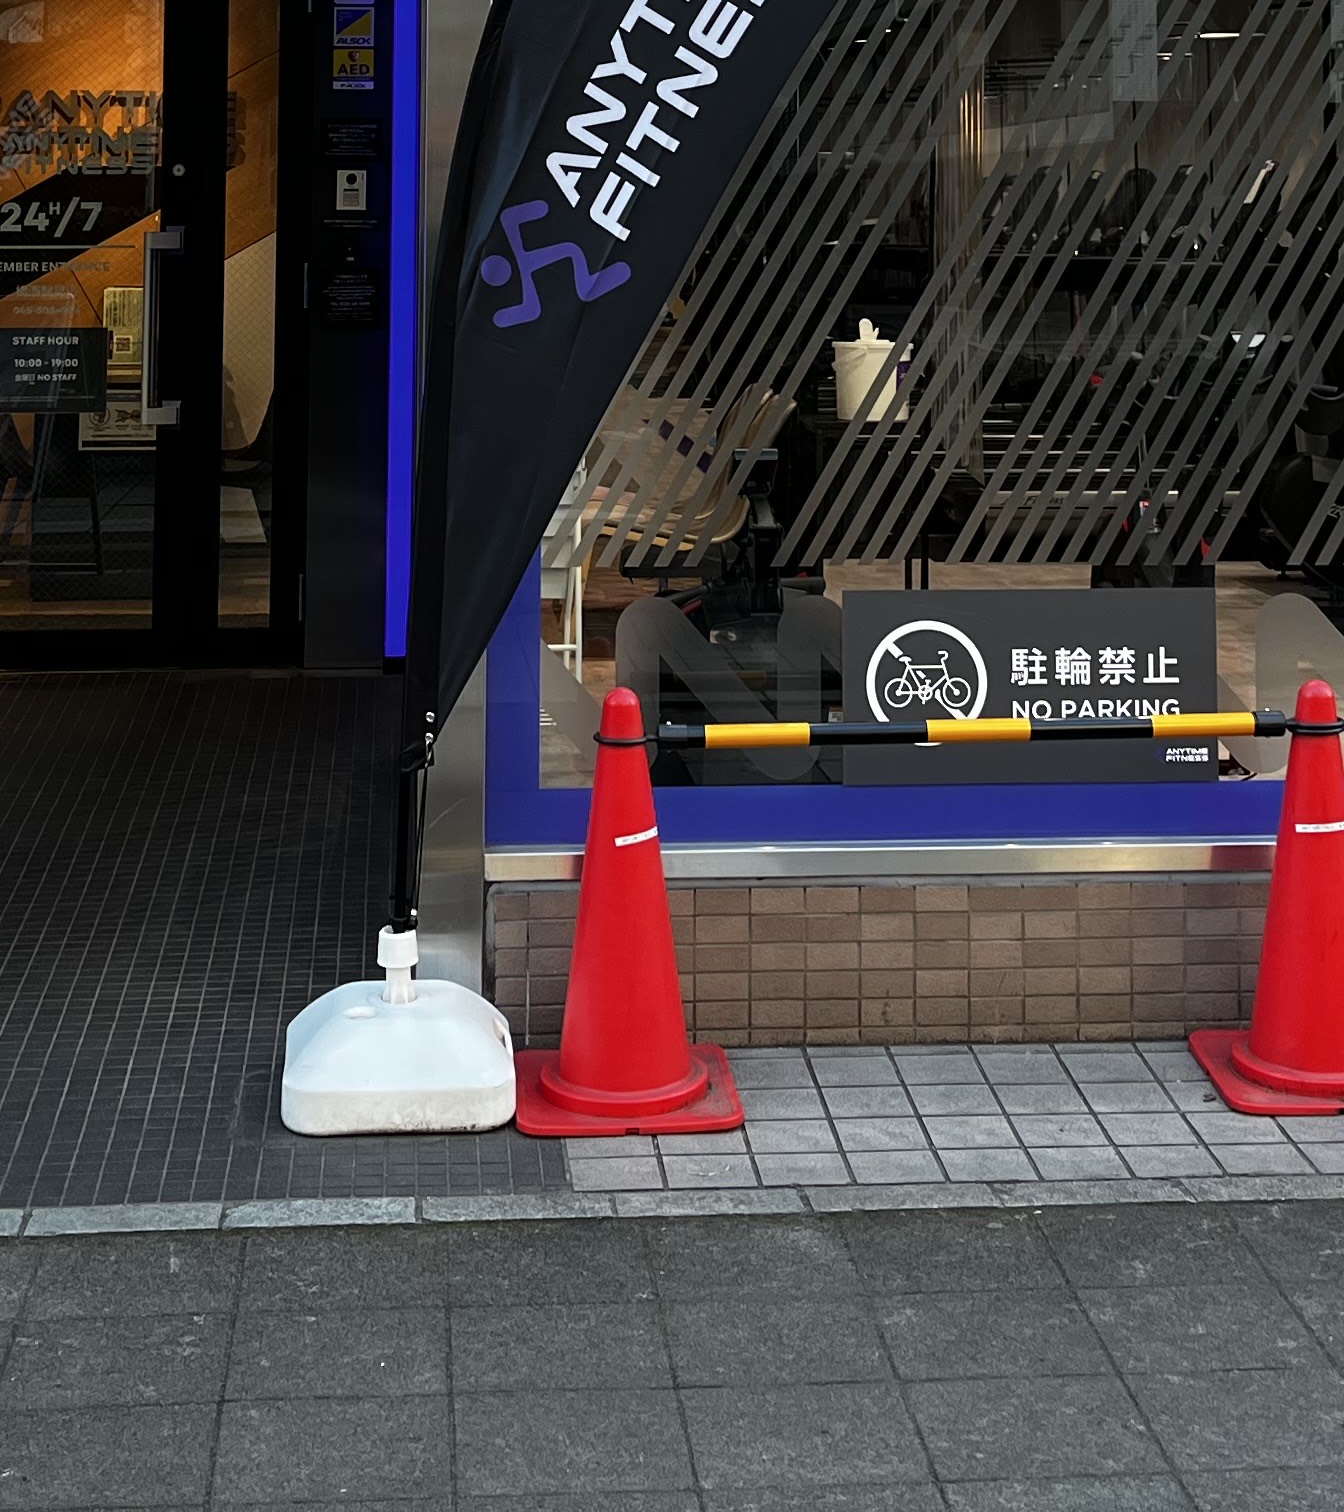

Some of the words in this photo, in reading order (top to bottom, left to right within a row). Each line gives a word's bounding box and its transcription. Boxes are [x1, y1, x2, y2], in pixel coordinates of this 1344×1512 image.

[337, 64, 370, 75] AED
[12, 336, 46, 346] STAFF
[47, 336, 80, 346] HOUR
[14, 358, 43, 368] 10:00
[51, 358, 79, 368] 19:00
[37, 373, 51, 382] NO
[52, 373, 77, 382] STAFF
[1010, 646, 1181, 686] 駐輪禁止
[1012, 699, 1053, 720] NO
[1061, 698, 1181, 719] PARKING
[1165, 747, 1208, 755] ANYTIME
[1165, 754, 1209, 762] FITNESS
